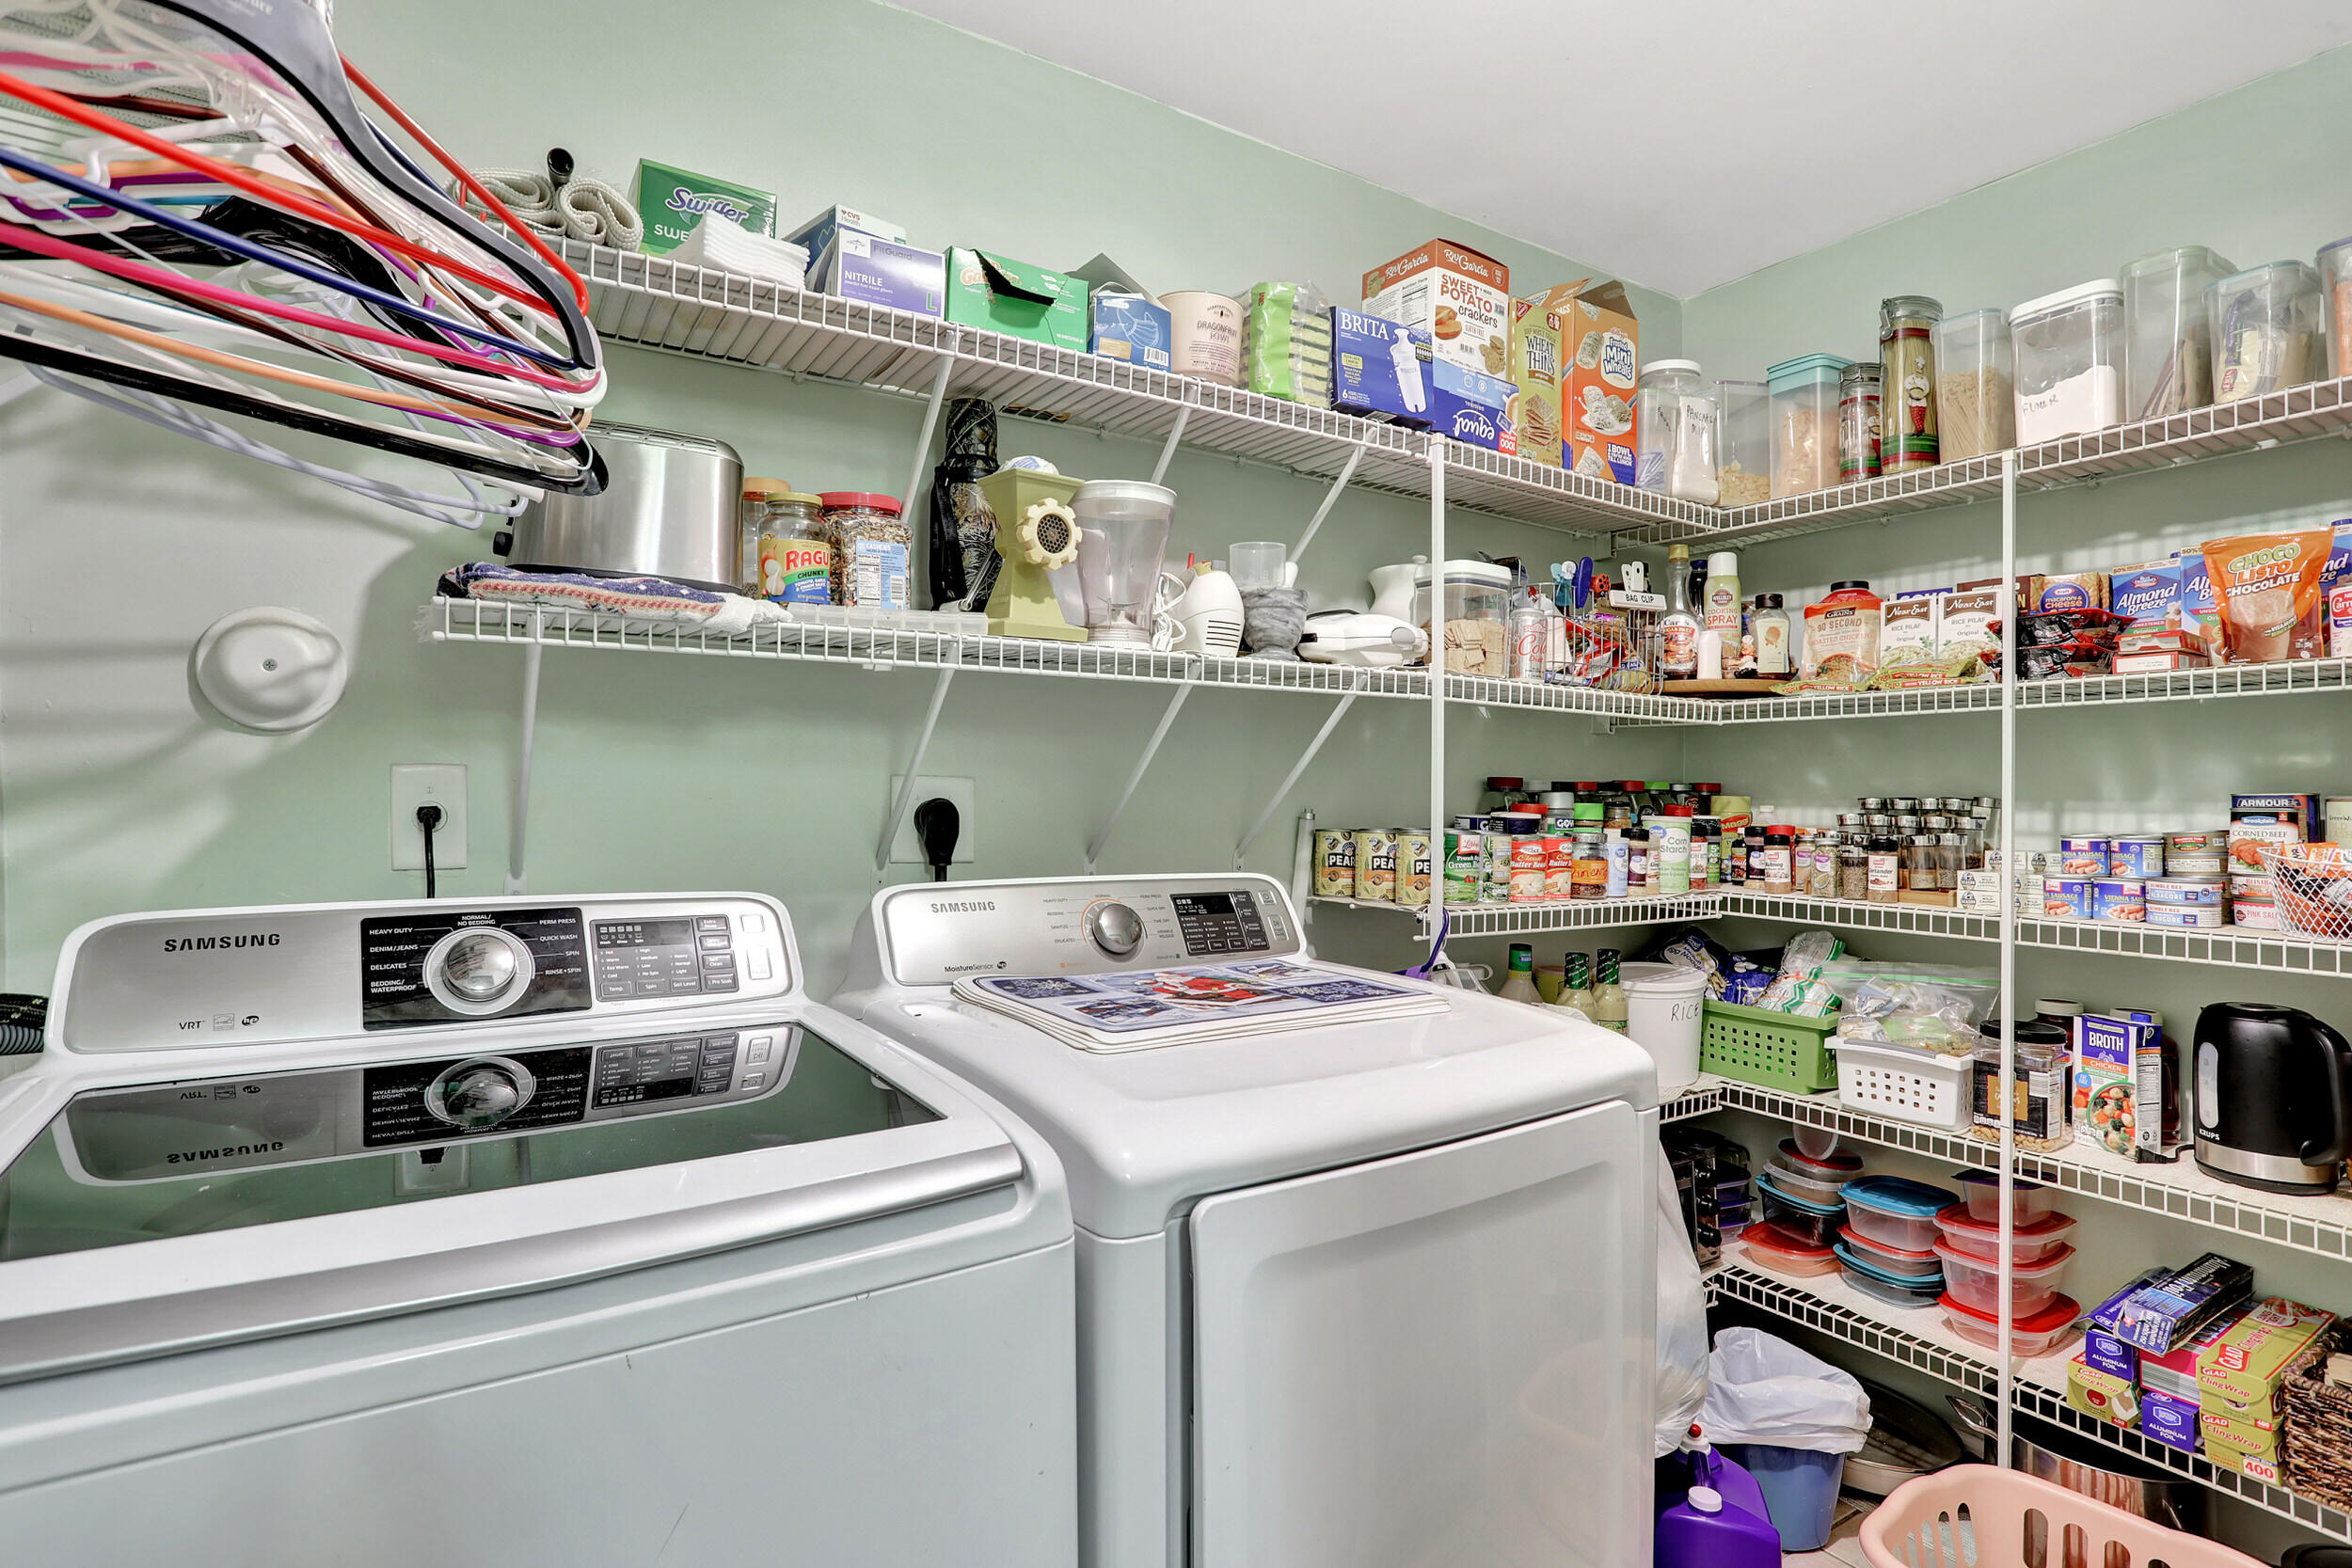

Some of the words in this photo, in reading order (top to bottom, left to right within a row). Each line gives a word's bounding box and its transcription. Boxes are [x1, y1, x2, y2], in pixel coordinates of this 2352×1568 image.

[666, 187, 749, 224] Swiffer
[847, 212, 861, 221] CVS
[873, 245, 913, 261] FitGuard
[1398, 253, 1429, 276] Garcia
[1458, 256, 1489, 277] Garcia
[844, 270, 883, 287] NITRILE
[1440, 274, 1480, 295] SWEET
[925, 292, 938, 311] L
[1440, 284, 1493, 313] POTATO
[1459, 305, 1499, 329] crackers
[1197, 320, 1238, 338] DRAGONFRUIT
[1341, 312, 1390, 341] BRITA
[1525, 336, 1555, 356] WHEAT
[1606, 345, 1632, 368] Mini
[1603, 359, 1633, 381] Wheats
[1343, 388, 1348, 399] 6
[1454, 410, 1495, 441] equal
[1500, 439, 1516, 452] 1000
[2229, 543, 2301, 573] CHOCO
[797, 570, 824, 579] CHUNKY
[2235, 560, 2293, 586] LISTO
[2226, 571, 2301, 598] CHOCOLATE
[1625, 594, 1639, 603] BAG
[1641, 594, 1655, 604] CLIP
[1946, 599, 1975, 612] Near
[1975, 596, 1994, 610] East
[2116, 582, 2178, 610] Almond
[1887, 606, 1910, 619] Near
[1910, 603, 1929, 616] East
[2127, 596, 2168, 617] Breeze
[1708, 615, 1739, 626] SPRAY
[1817, 623, 1827, 633] 90
[1829, 618, 1863, 630] SECOND
[1951, 617, 1966, 626] RICE
[1967, 616, 1987, 626] PILAF
[2241, 799, 2289, 807] ARMOUR
[1667, 836, 1688, 846] Corn
[2233, 830, 2268, 838] CORNED
[1660, 845, 1688, 854] Starch
[1328, 855, 1355, 867] PEAR
[1373, 858, 1395, 869] PEA
[1448, 861, 1472, 870] Green
[930, 901, 996, 914] SAMSUNG
[2247, 910, 2262, 918] PINK
[164, 933, 281, 953] SAMSUNG
[371, 979, 405, 988] BEDDING/
[371, 984, 417, 994] WATERPROOF
[179, 1021, 202, 1031] VRT
[2089, 1031, 2125, 1053] BROTH
[2090, 1060, 2122, 1072] CHICKEN
[2199, 1128, 2220, 1141] KRUPS
[2091, 1354, 2128, 1370] ALUMINUM
[2102, 1360, 2119, 1371] FOIL
[2218, 1346, 2244, 1370] GLAD
[2079, 1368, 2104, 1380] GLAD
[2201, 1367, 2227, 1378] GLAD
[2201, 1415, 2228, 1426] GLAD
[2149, 1422, 2187, 1441] ALUMINUM
[2159, 1432, 2176, 1442] FOIL
[2245, 1462, 2274, 1480] 400
